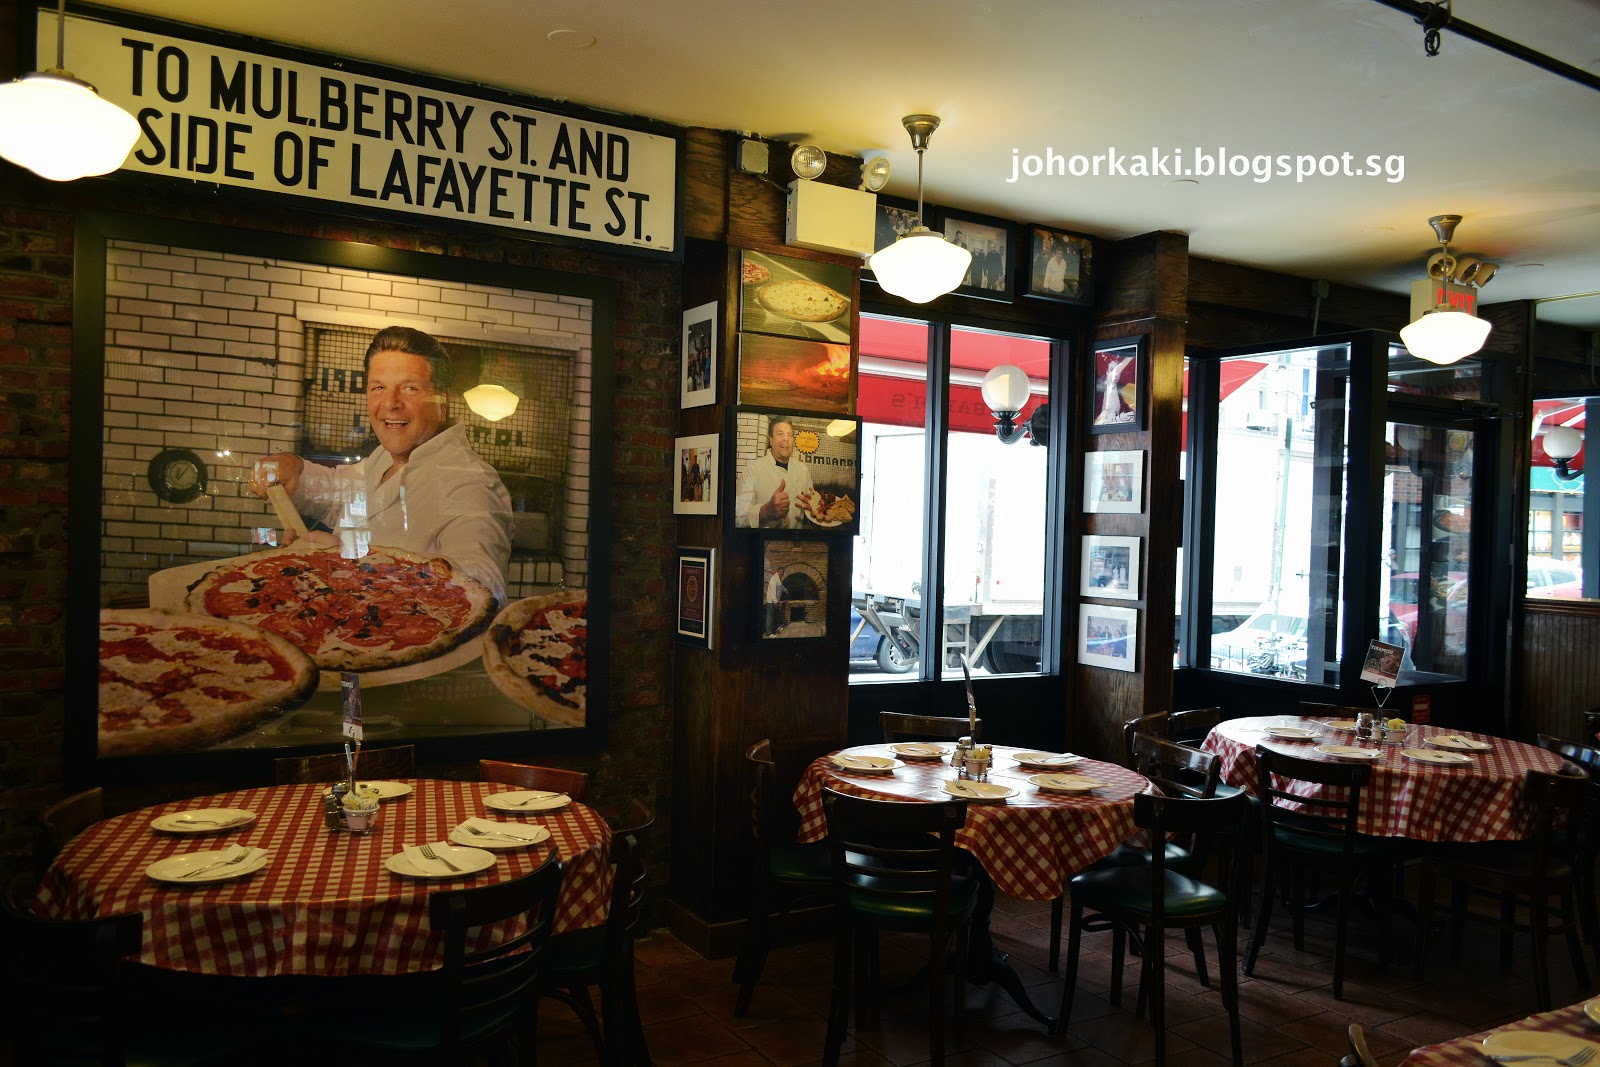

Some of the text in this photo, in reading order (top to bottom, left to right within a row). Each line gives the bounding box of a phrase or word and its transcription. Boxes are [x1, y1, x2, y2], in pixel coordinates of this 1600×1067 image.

[121, 37, 630, 183] TO MULBERRY ST. AND
[134, 107, 652, 242] SIDE OF LAFAYETTE ST.
[321, 367, 367, 395] 190
[798, 454, 857, 468] LOMBARD
